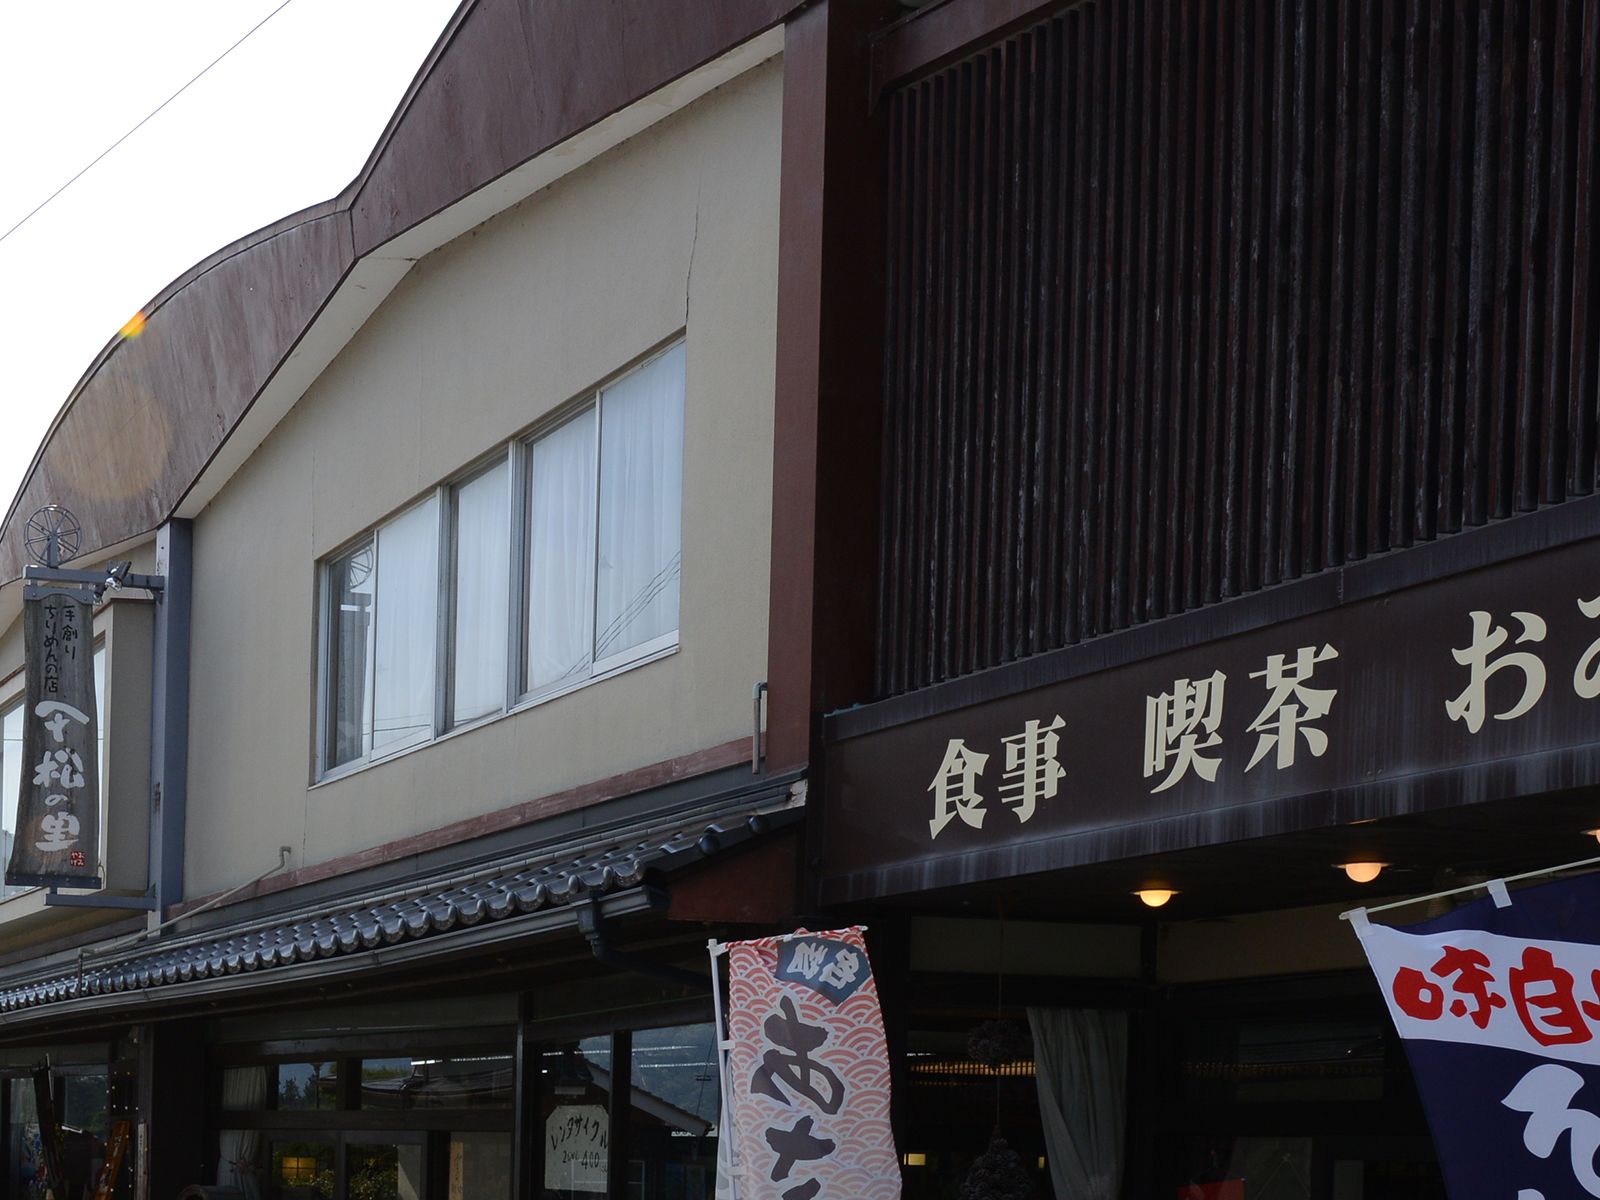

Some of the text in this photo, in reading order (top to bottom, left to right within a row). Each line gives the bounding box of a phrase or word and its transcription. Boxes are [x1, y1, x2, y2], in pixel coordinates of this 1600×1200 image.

[43, 604, 59, 693] ちりめんの店
[927, 714, 1067, 840] 食事
[1142, 642, 1339, 794] 喫茶
